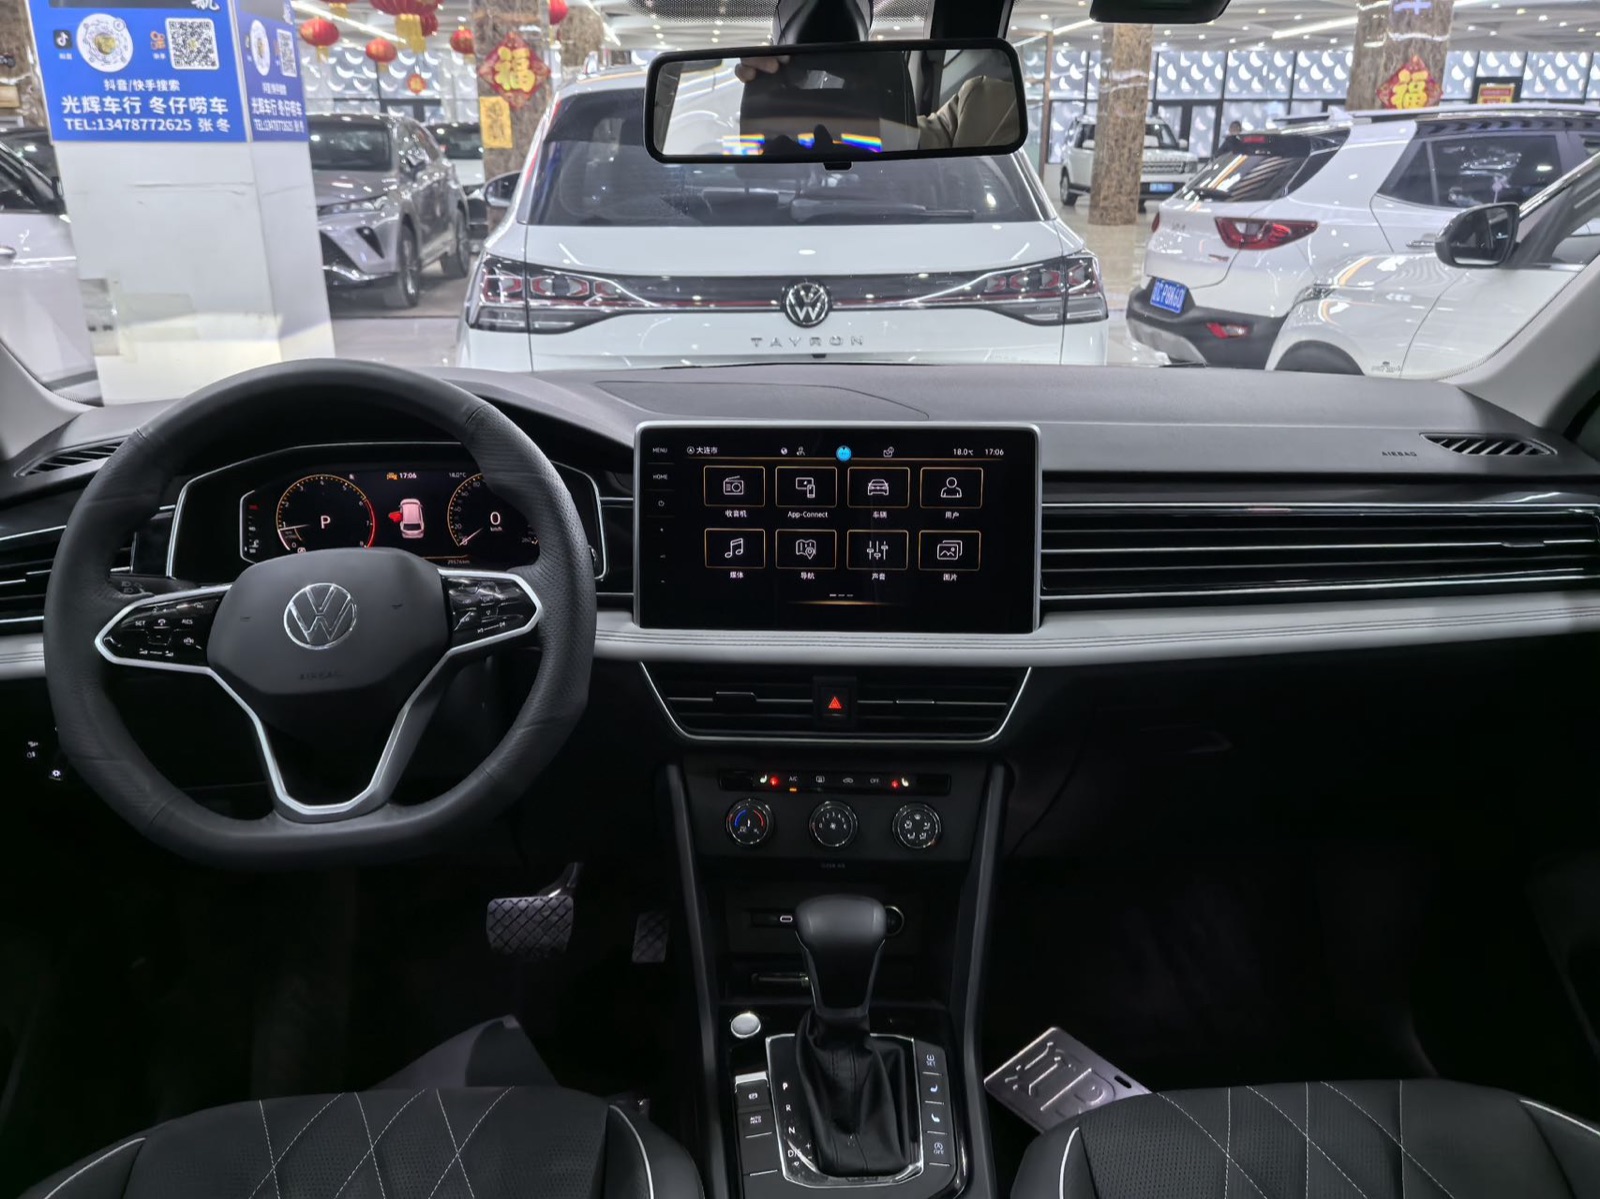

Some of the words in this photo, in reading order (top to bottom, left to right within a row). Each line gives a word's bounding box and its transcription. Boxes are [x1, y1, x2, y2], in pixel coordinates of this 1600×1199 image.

[493, 46, 536, 93] 福
[103, 79, 181, 92] 抖音/快手搜索
[1391, 70, 1428, 109] 福
[61, 95, 142, 115] 光辉车行
[149, 96, 229, 115] 冬仔唠车
[64, 118, 192, 131] TEL:13478772625
[750, 336, 864, 348] TAYRON
[652, 446, 668, 454] MENU
[696, 446, 718, 455] 大连市
[984, 448, 1004, 456] 17:06
[399, 472, 417, 480] 17:06
[489, 511, 501, 526] 0
[725, 510, 748, 518] 收音机
[787, 510, 829, 520] App-Connect
[945, 510, 960, 520] 用户
[320, 514, 331, 529] P
[729, 571, 744, 580] 媒体
[800, 571, 816, 580] 导航
[871, 572, 887, 581] 声音
[943, 573, 959, 582] 图片
